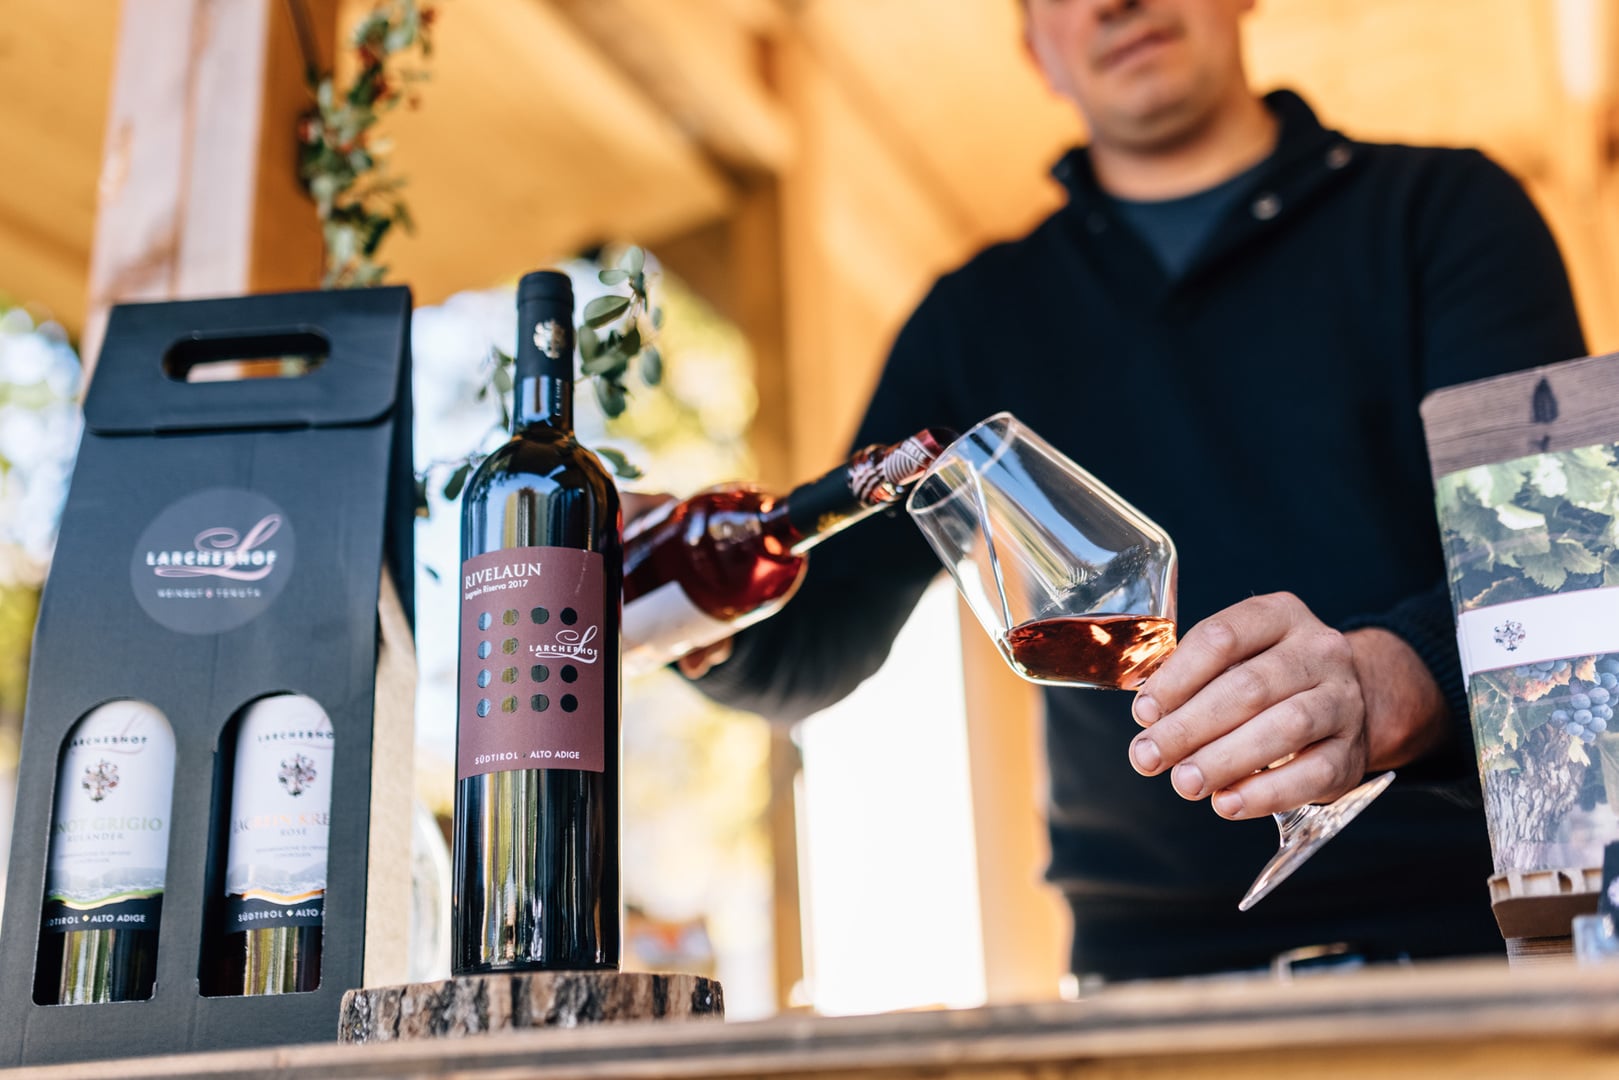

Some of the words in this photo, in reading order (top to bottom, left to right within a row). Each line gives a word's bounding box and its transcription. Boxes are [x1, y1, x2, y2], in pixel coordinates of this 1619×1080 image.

[146, 550, 277, 566] LARCHERHOF
[465, 563, 542, 589] RIVELAUN
[216, 588, 261, 599] TENUTA
[482, 582, 507, 594] Riserva
[508, 580, 528, 589] 2017
[529, 645, 598, 656] LARCHERHOF
[71, 735, 147, 747] ARCHERHOF
[258, 731, 335, 742] LARCHERHO
[475, 752, 518, 765] SÜDTIROL
[530, 750, 552, 759] ALTO
[555, 750, 580, 760] ADIGE
[95, 816, 163, 832] GRIGIO
[91, 915, 115, 923] ALTO
[116, 914, 146, 923] ADIGE
[238, 910, 283, 922] SÜDTIROL
[295, 909, 319, 917] ALTO
